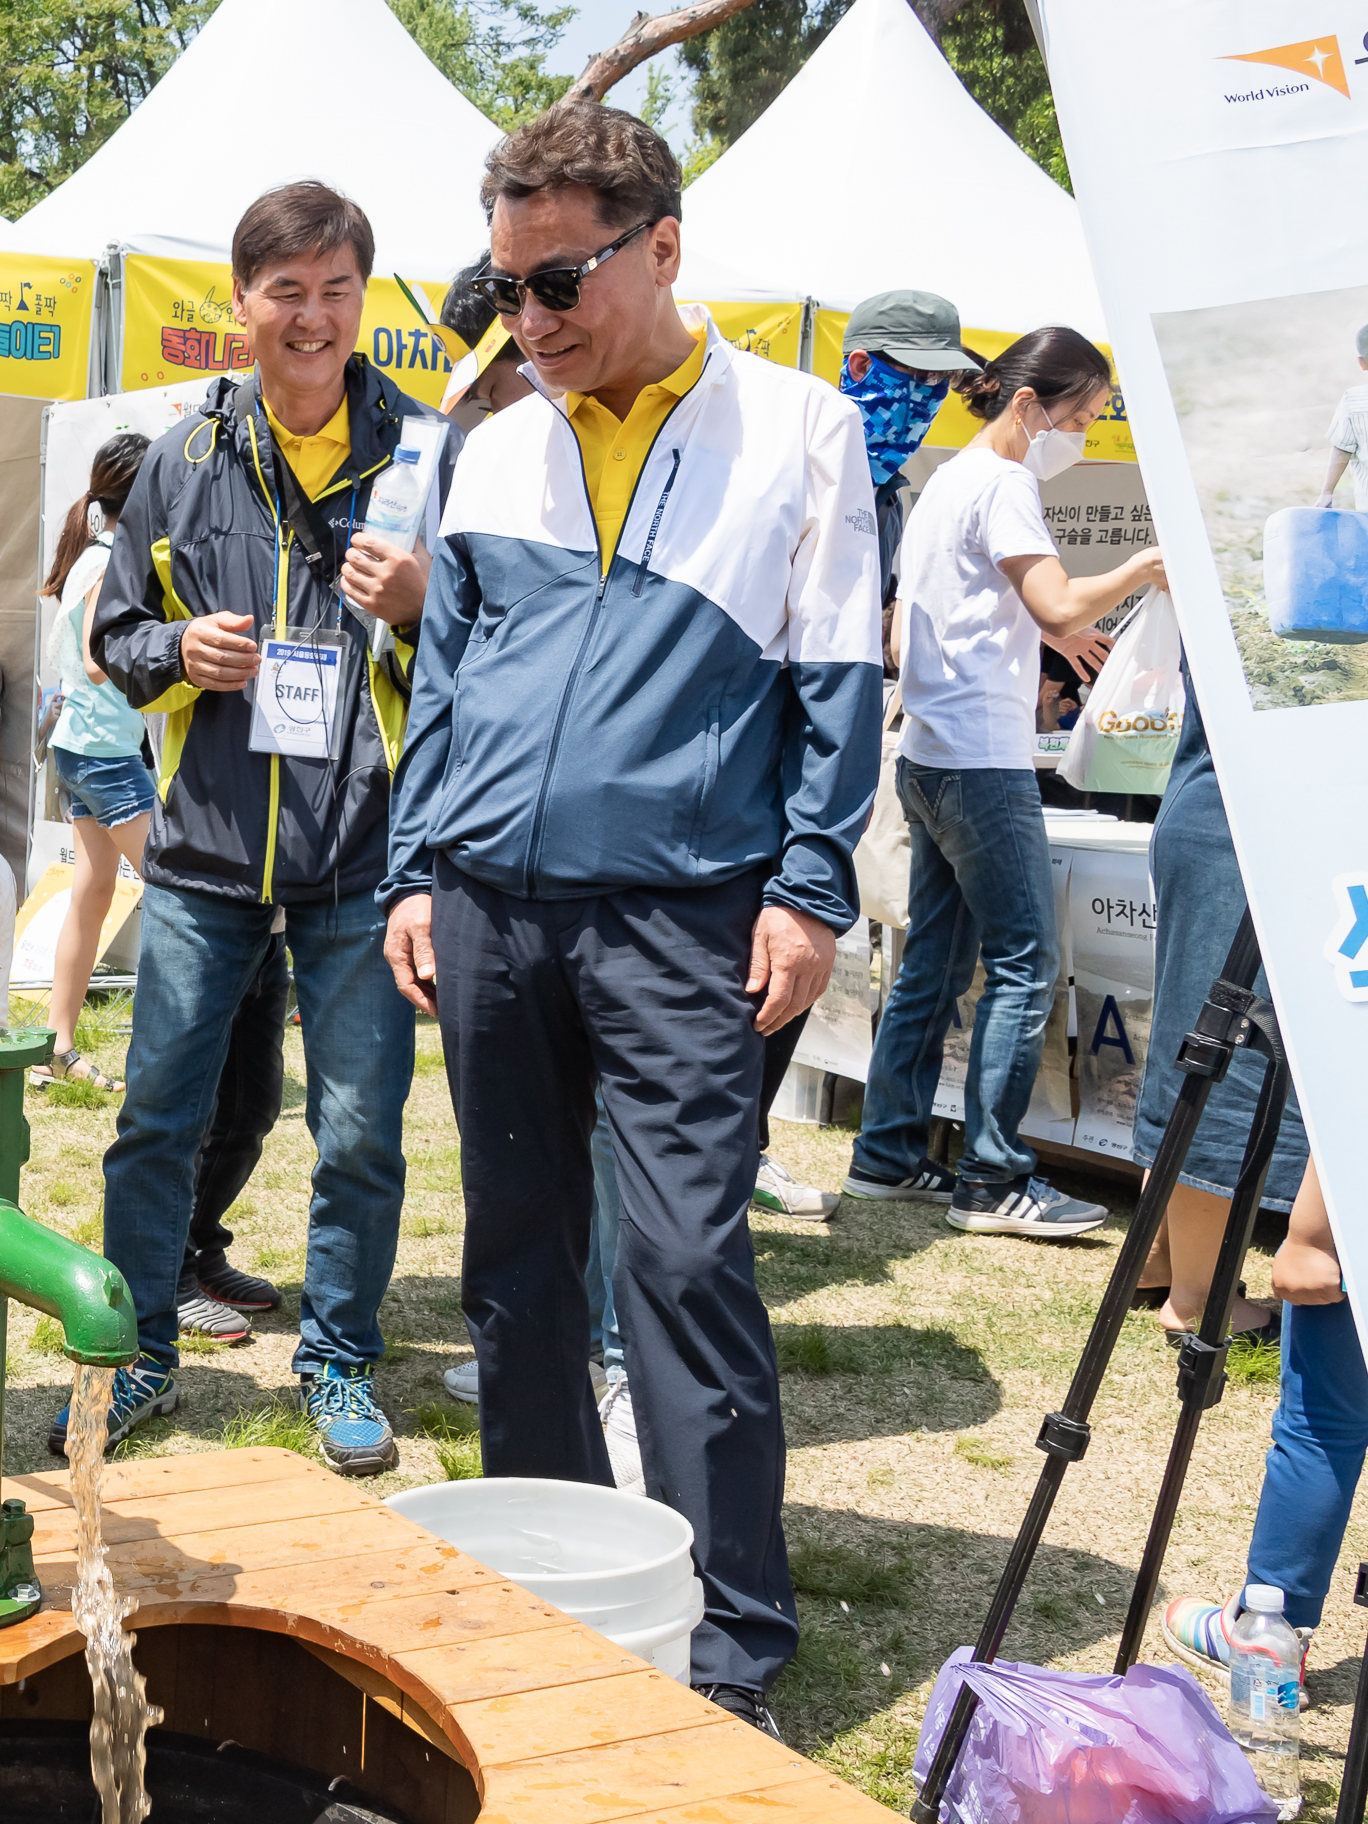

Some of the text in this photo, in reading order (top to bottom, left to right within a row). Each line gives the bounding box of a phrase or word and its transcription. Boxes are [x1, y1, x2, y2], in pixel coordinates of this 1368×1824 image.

[1224, 83, 1310, 104] World Vision
[172, 300, 195, 323] 와글
[1043, 505, 1081, 522] 자신이
[1086, 505, 1125, 522] 만들고
[642, 491, 670, 562] THE NORTH FACE
[1054, 527, 1152, 545] 구슬을 고릅니다.
[275, 684, 320, 702] STAFF
[1092, 898, 1157, 929] 아차산
[1089, 994, 1136, 1066] A
